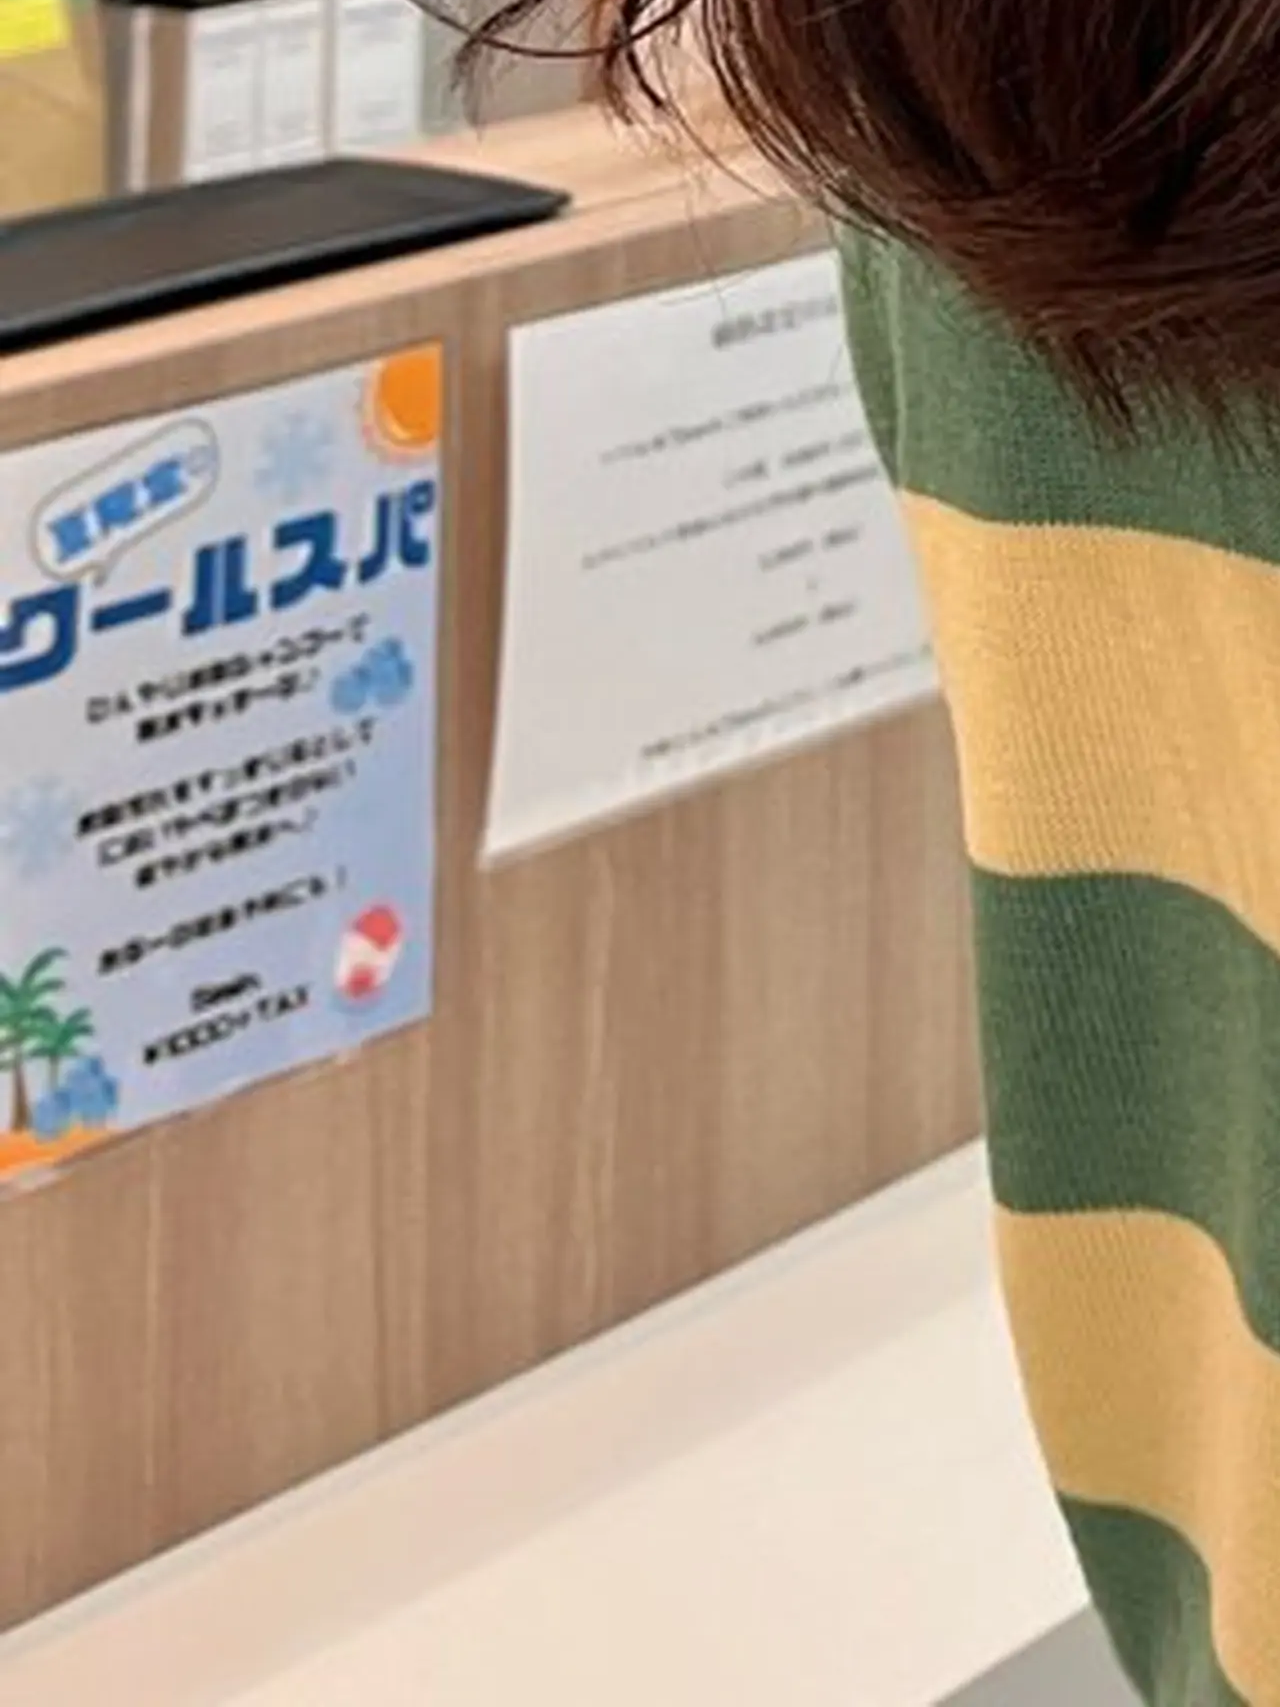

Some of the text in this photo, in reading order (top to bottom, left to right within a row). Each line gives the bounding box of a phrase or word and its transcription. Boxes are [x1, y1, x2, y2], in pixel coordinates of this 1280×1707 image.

[0, 479, 436, 690] クールスパ
